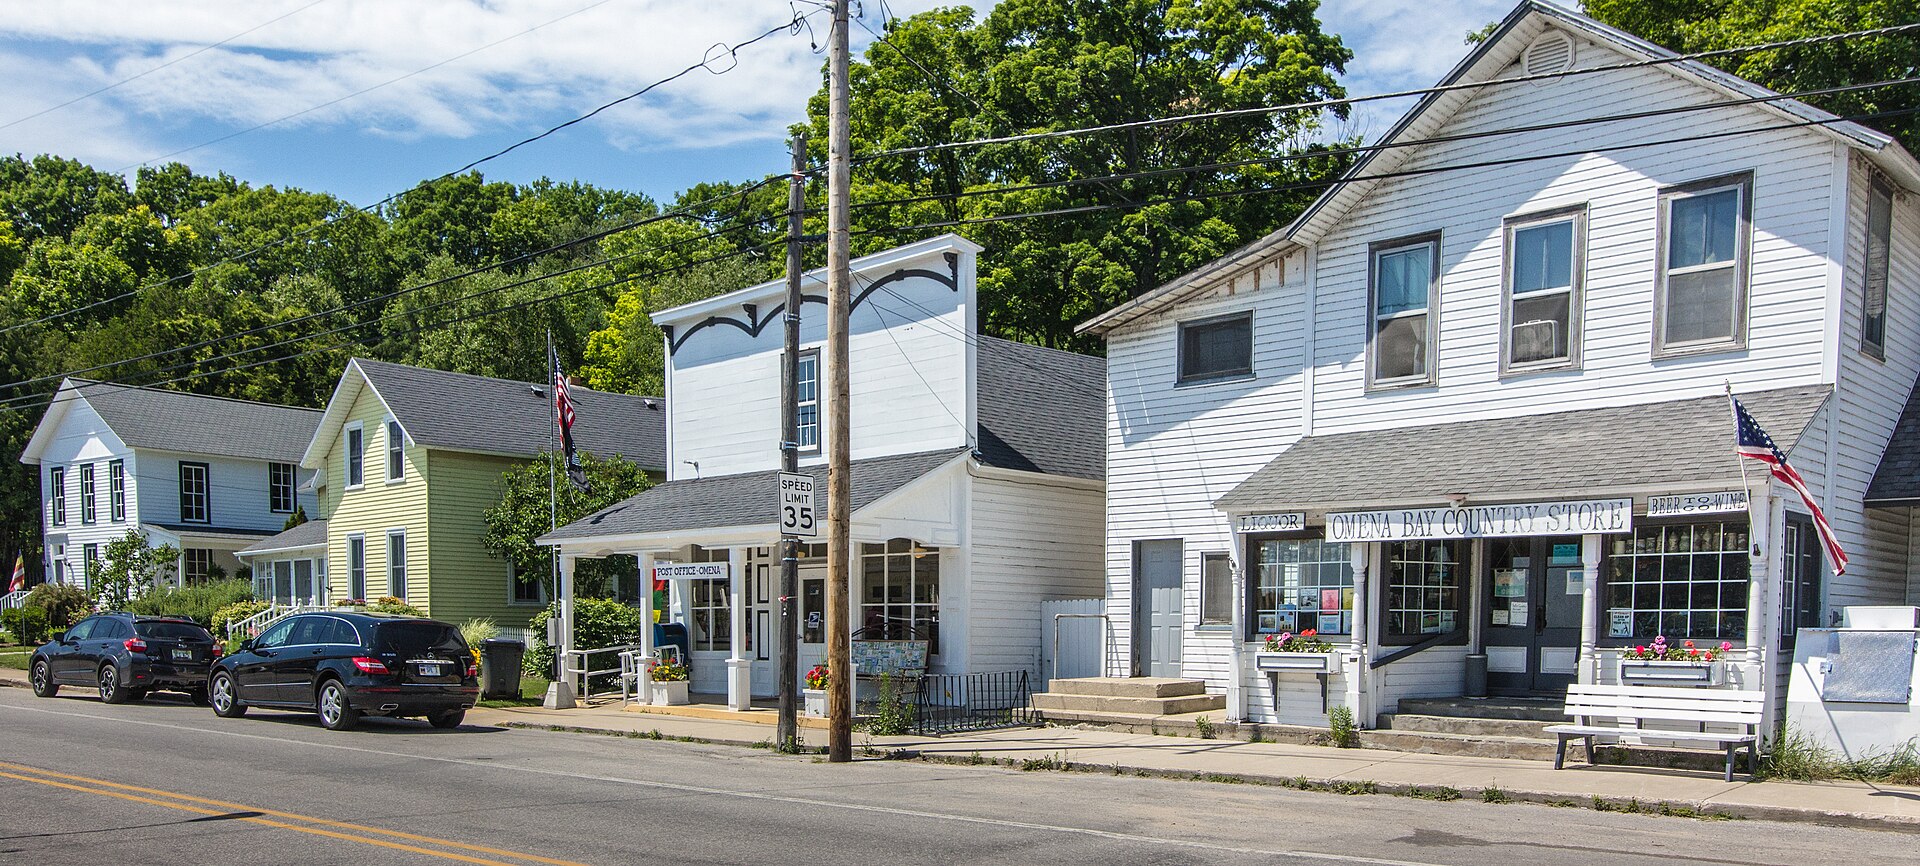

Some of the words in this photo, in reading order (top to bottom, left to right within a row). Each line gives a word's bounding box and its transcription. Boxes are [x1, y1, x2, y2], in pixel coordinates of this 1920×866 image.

[781, 479, 813, 492] SPEED
[785, 492, 809, 504] LIMIT
[1684, 496, 1710, 504] TO
[1652, 496, 1680, 514] BEER
[1683, 504, 1710, 512] GO
[784, 505, 813, 529] 35
[1241, 514, 1299, 531] LIQUOR
[1332, 512, 1392, 540] OMENA
[1401, 510, 1437, 538] BAY
[1442, 505, 1539, 535] COUNTRY
[1546, 501, 1624, 532] STORE
[657, 567, 673, 576] POST
